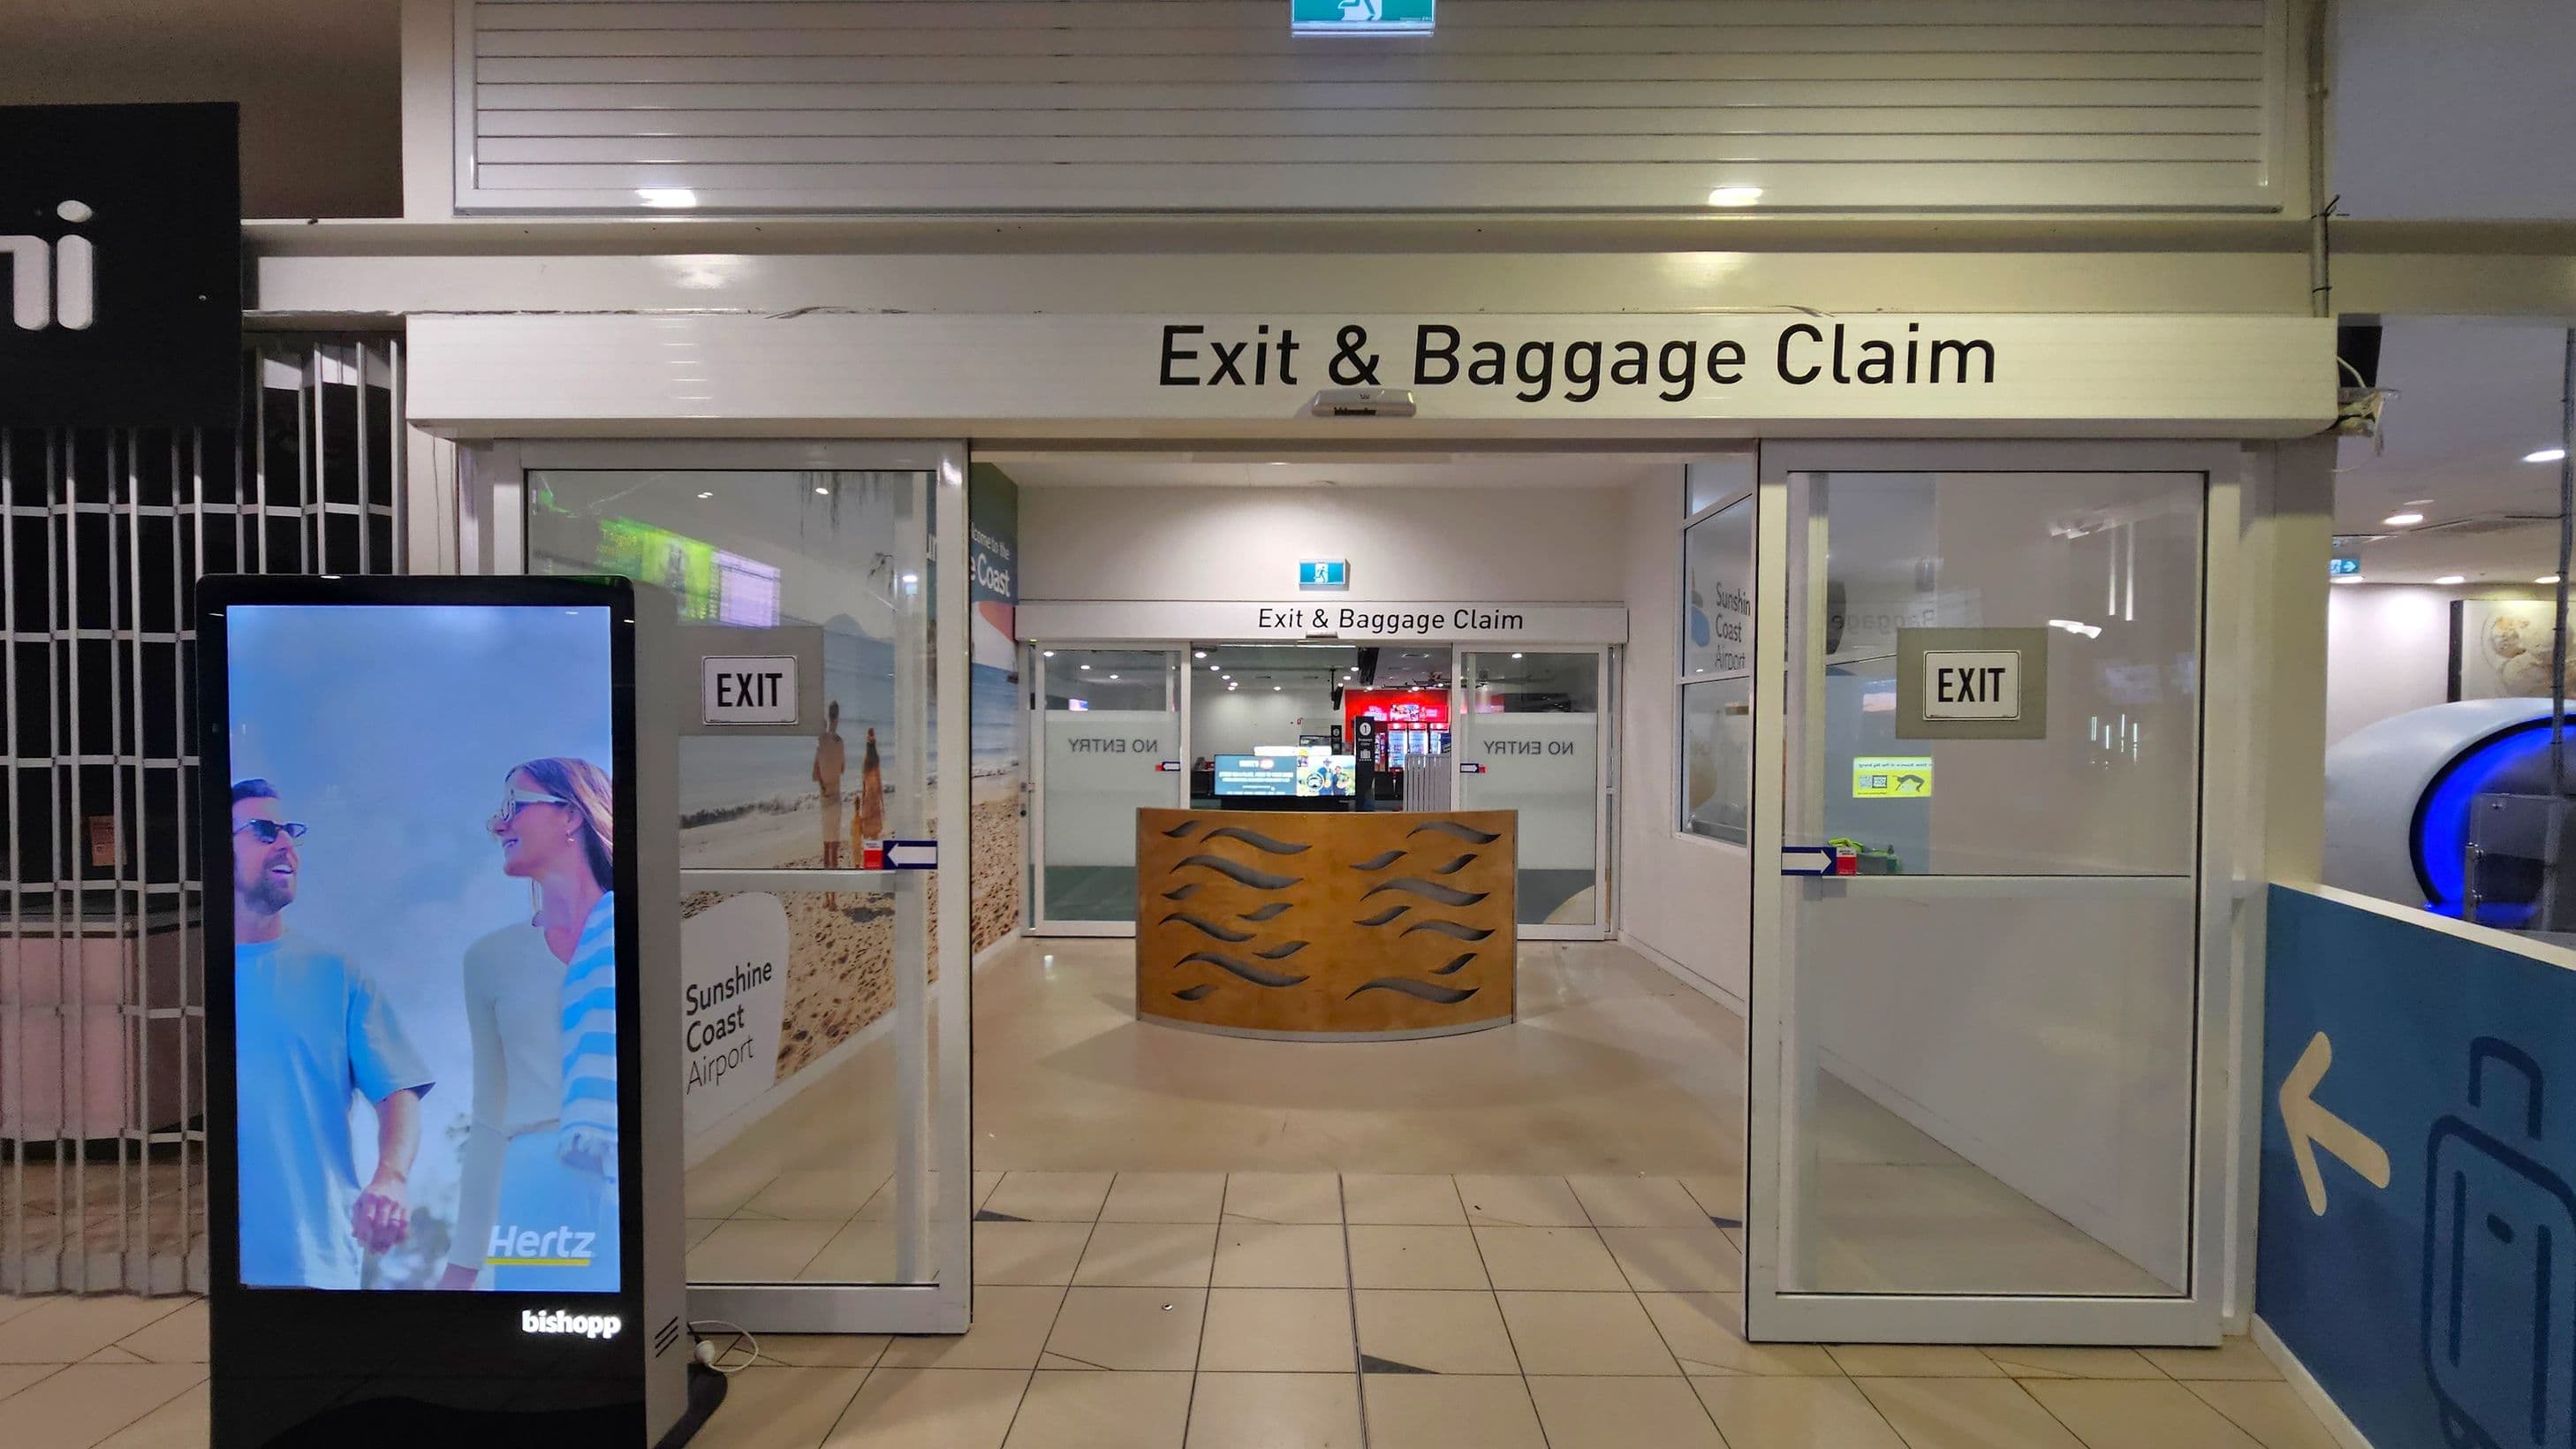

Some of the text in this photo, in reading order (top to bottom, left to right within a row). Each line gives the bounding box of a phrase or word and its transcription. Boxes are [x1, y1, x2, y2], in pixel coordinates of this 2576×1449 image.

[1159, 322, 1995, 403] Exit & Baggage Claim
[977, 552, 1011, 597] Coast
[1716, 581, 1752, 617] Sunshin
[1259, 608, 1524, 634] Exit & Baggage Claim
[1716, 612, 1742, 643] Coast
[717, 672, 783, 707] EXIT
[1938, 668, 2005, 702] EXIT
[686, 961, 773, 1015] Sunshine
[686, 1004, 745, 1052] Coast
[686, 1037, 754, 1095] Airport
[487, 1225, 595, 1258] Hertz
[521, 1309, 622, 1339] bishopp
